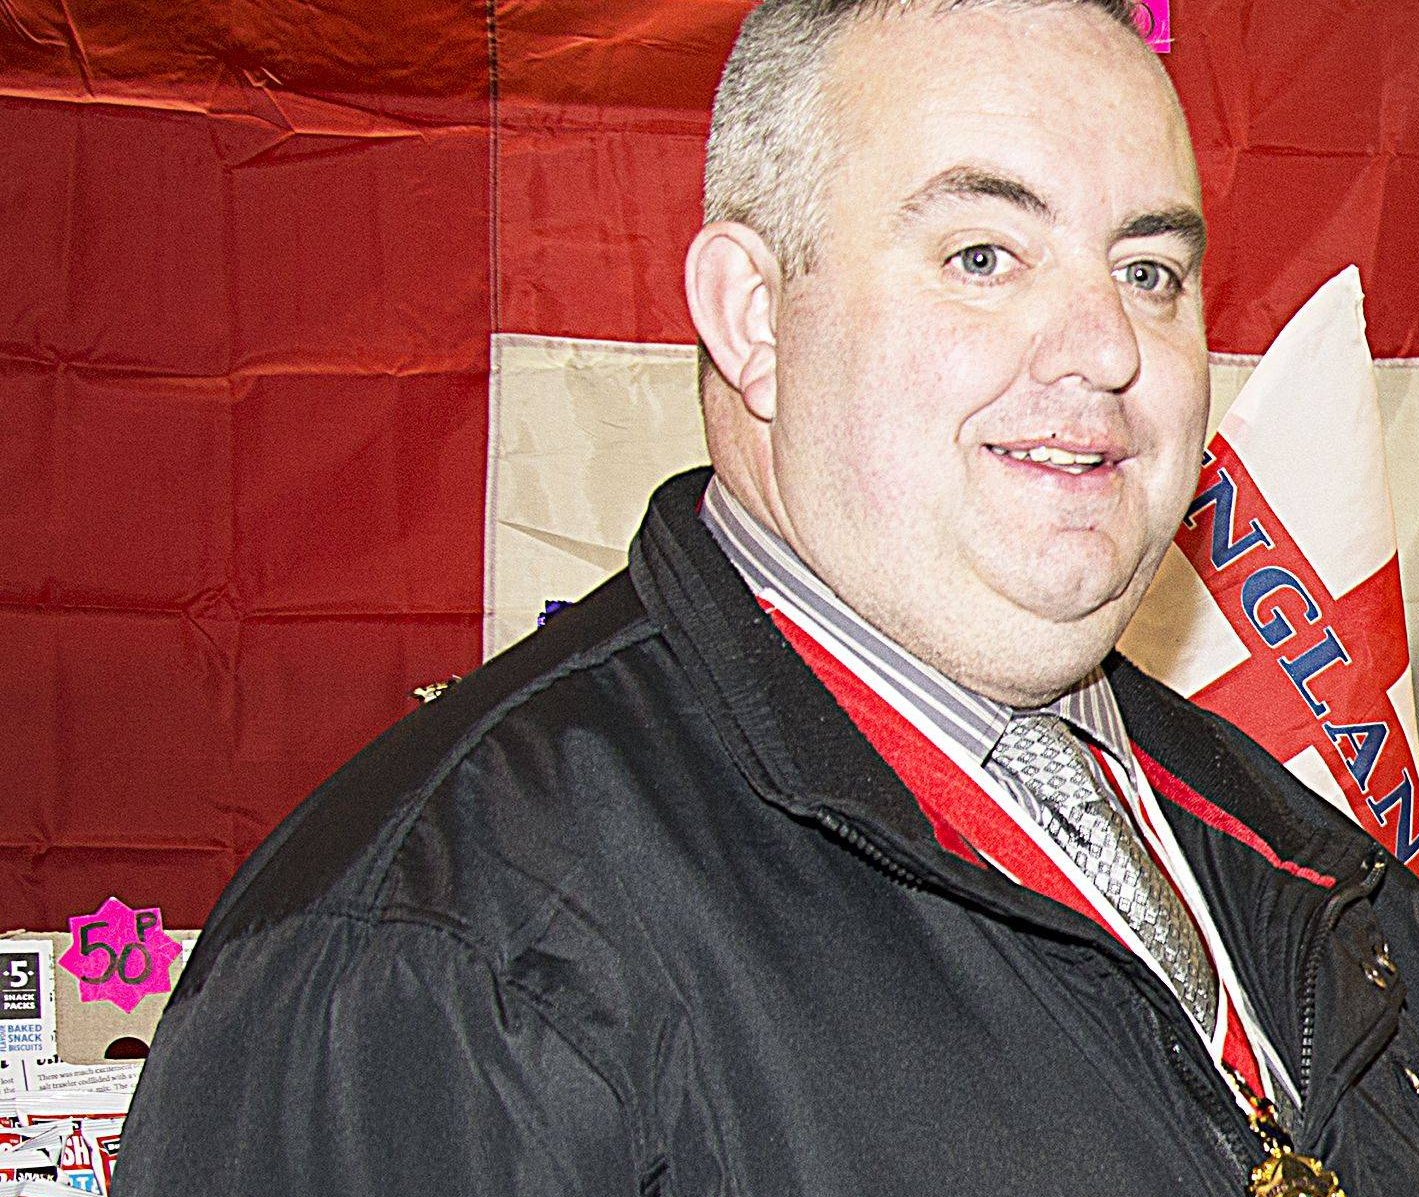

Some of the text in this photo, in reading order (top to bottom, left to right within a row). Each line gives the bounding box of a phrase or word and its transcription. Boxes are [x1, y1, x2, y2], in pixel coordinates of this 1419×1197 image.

[10, 960, 28, 987] 5
[4, 993, 34, 1001] SNACK
[4, 1002, 35, 1010] PACKS
[8, 1024, 42, 1033] BAKED
[8, 1034, 42, 1042] SNACK
[9, 1043, 42, 1052] BISCUITS
